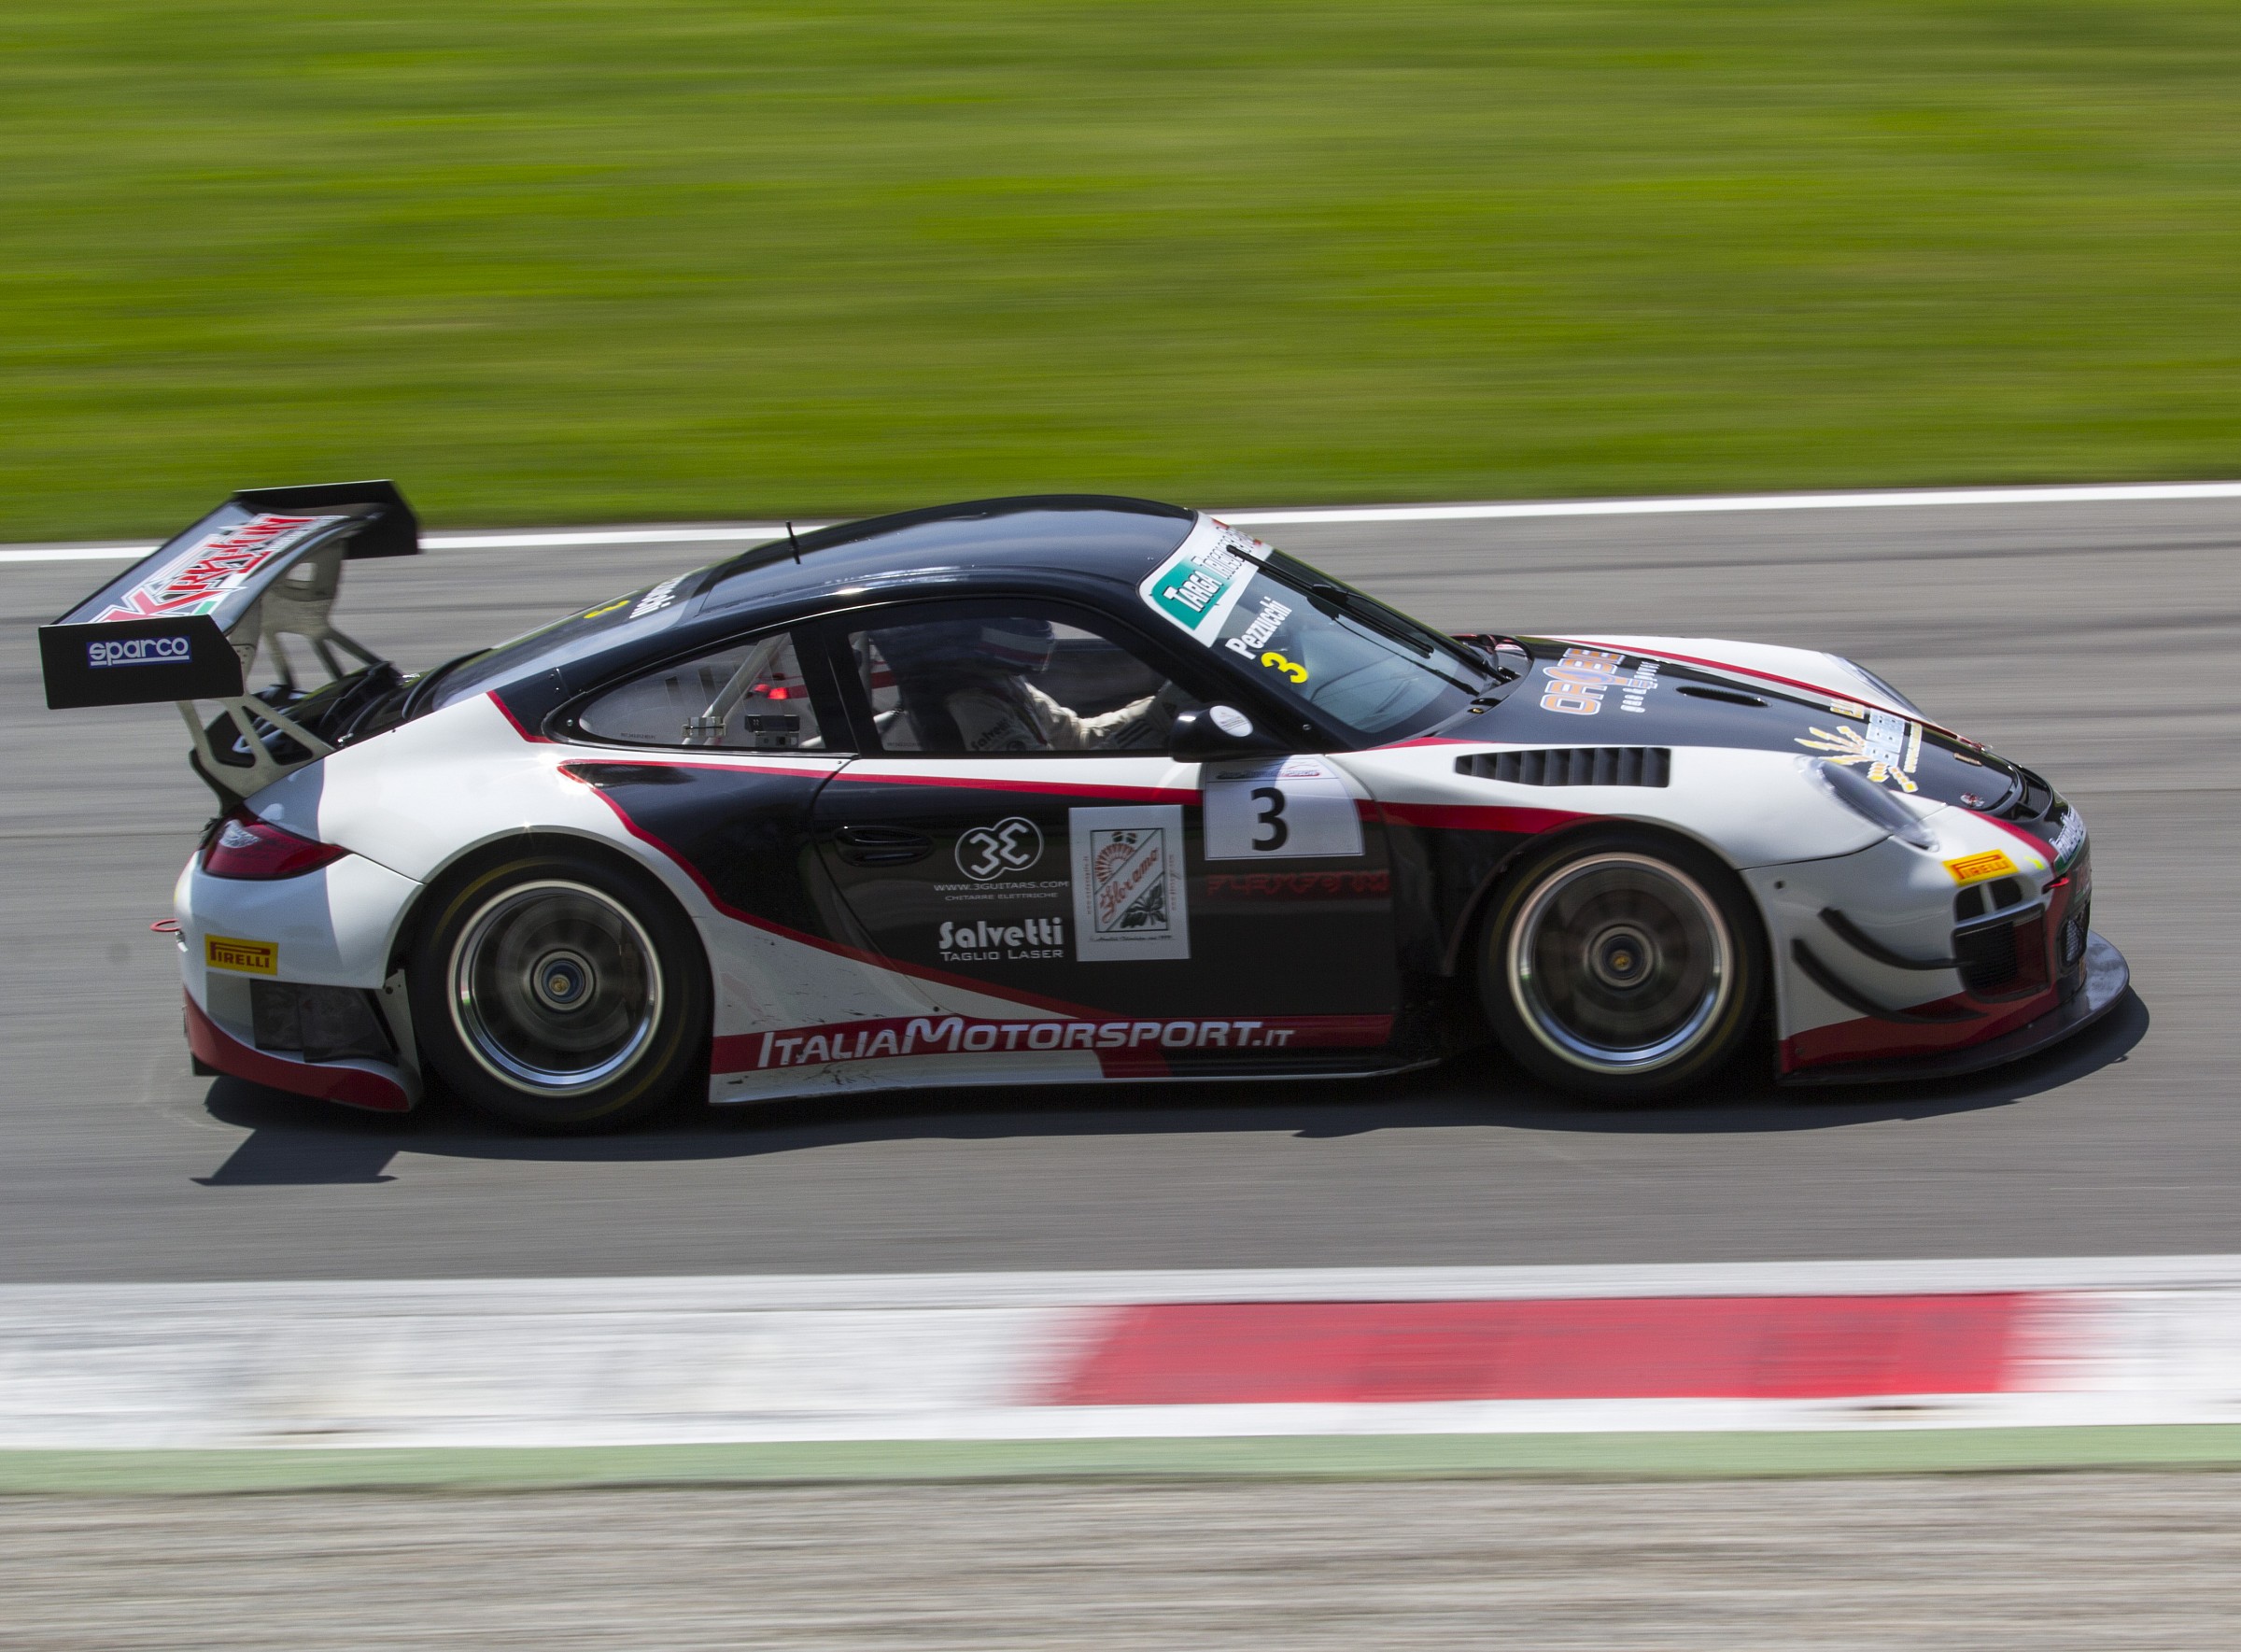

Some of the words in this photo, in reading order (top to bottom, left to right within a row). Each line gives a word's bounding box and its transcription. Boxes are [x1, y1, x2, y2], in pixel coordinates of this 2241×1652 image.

[1163, 570, 1223, 613] TARGA
[1225, 596, 1292, 659] Pezzucchi
[89, 637, 190, 666] sparco
[1261, 652, 1308, 684] 3
[1251, 787, 1288, 851] 3
[1951, 854, 2009, 879] PIRELLI
[939, 917, 1064, 949] Salvetti
[210, 940, 271, 968] PIRELLI
[939, 951, 1000, 962] TAGLIO
[1008, 949, 1064, 959] LASER
